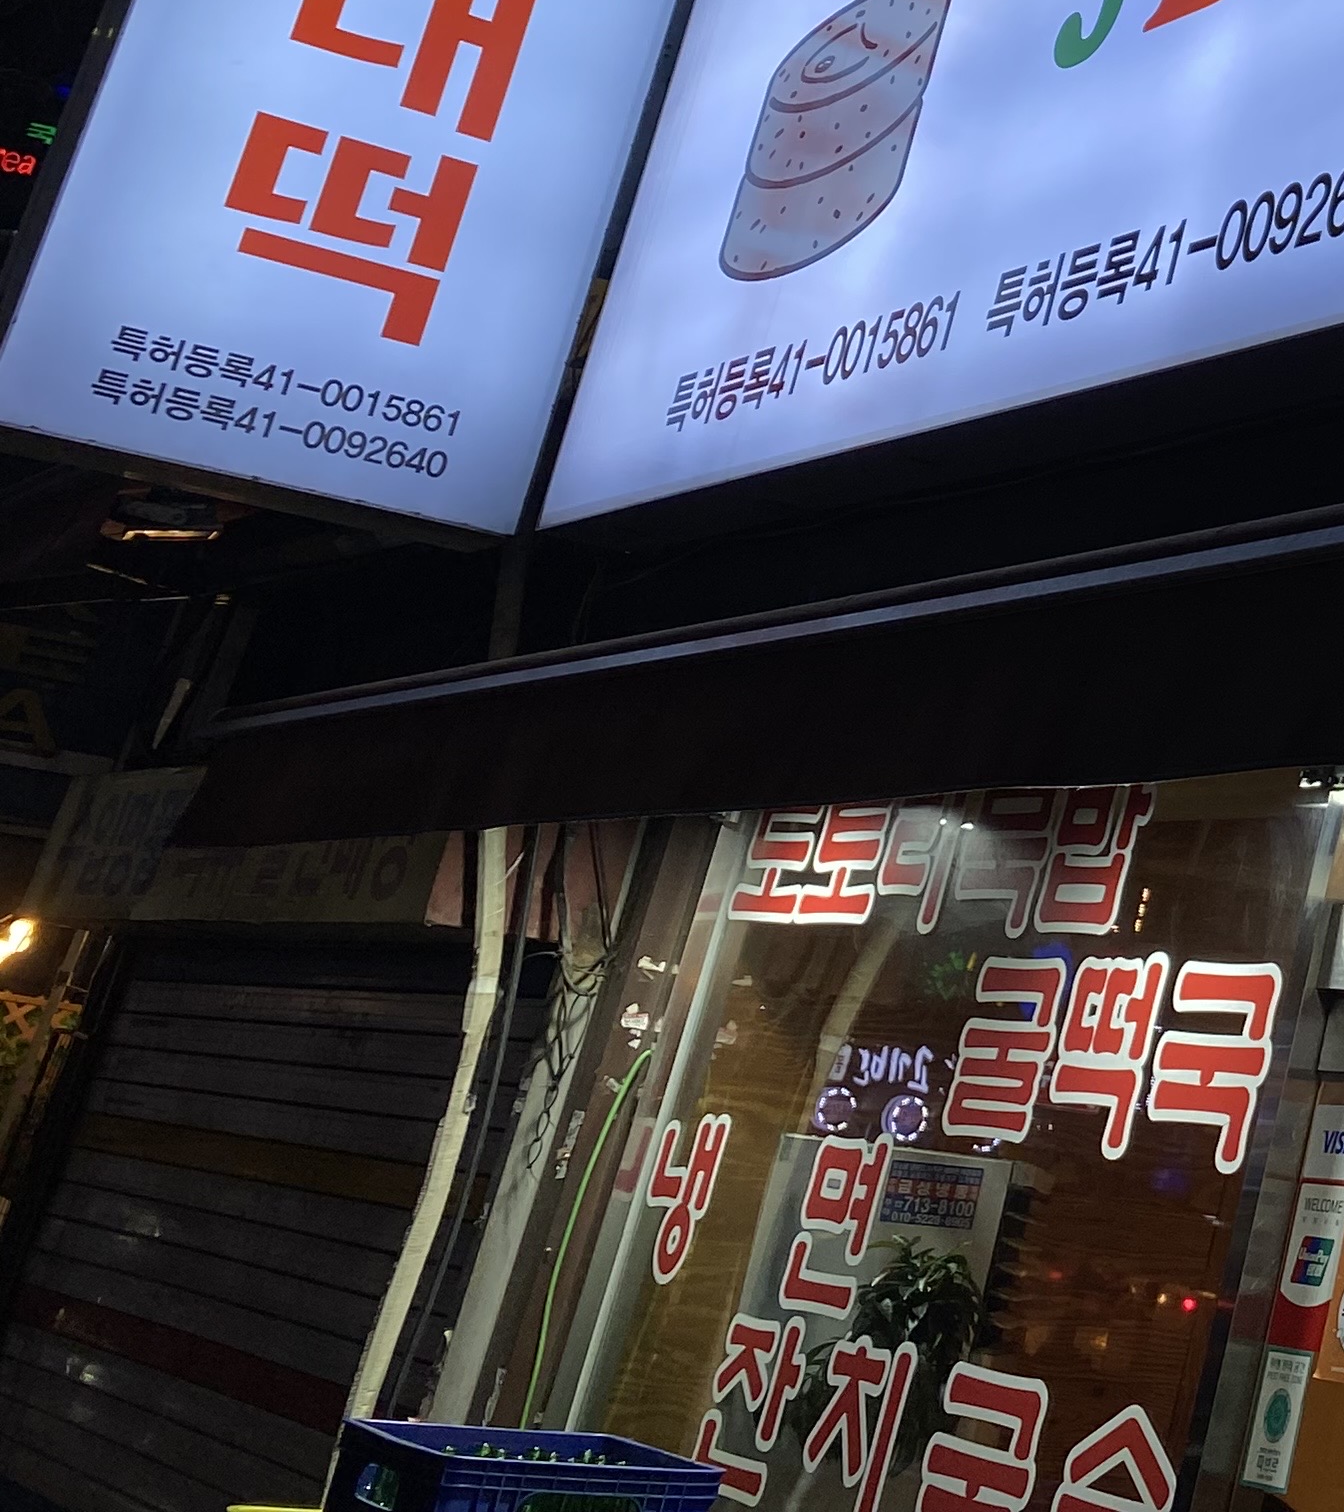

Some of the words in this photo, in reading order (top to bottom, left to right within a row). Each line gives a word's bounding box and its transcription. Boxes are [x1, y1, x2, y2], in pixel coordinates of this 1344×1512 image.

[110, 324, 461, 438] 특허등록41-0015861
[665, 290, 961, 433] 특허등록41-0015861
[90, 367, 448, 479] 특허등록41-0092640
[942, 950, 1283, 1174] 굴떡국
[1304, 1197, 1344, 1214] WELCOME
